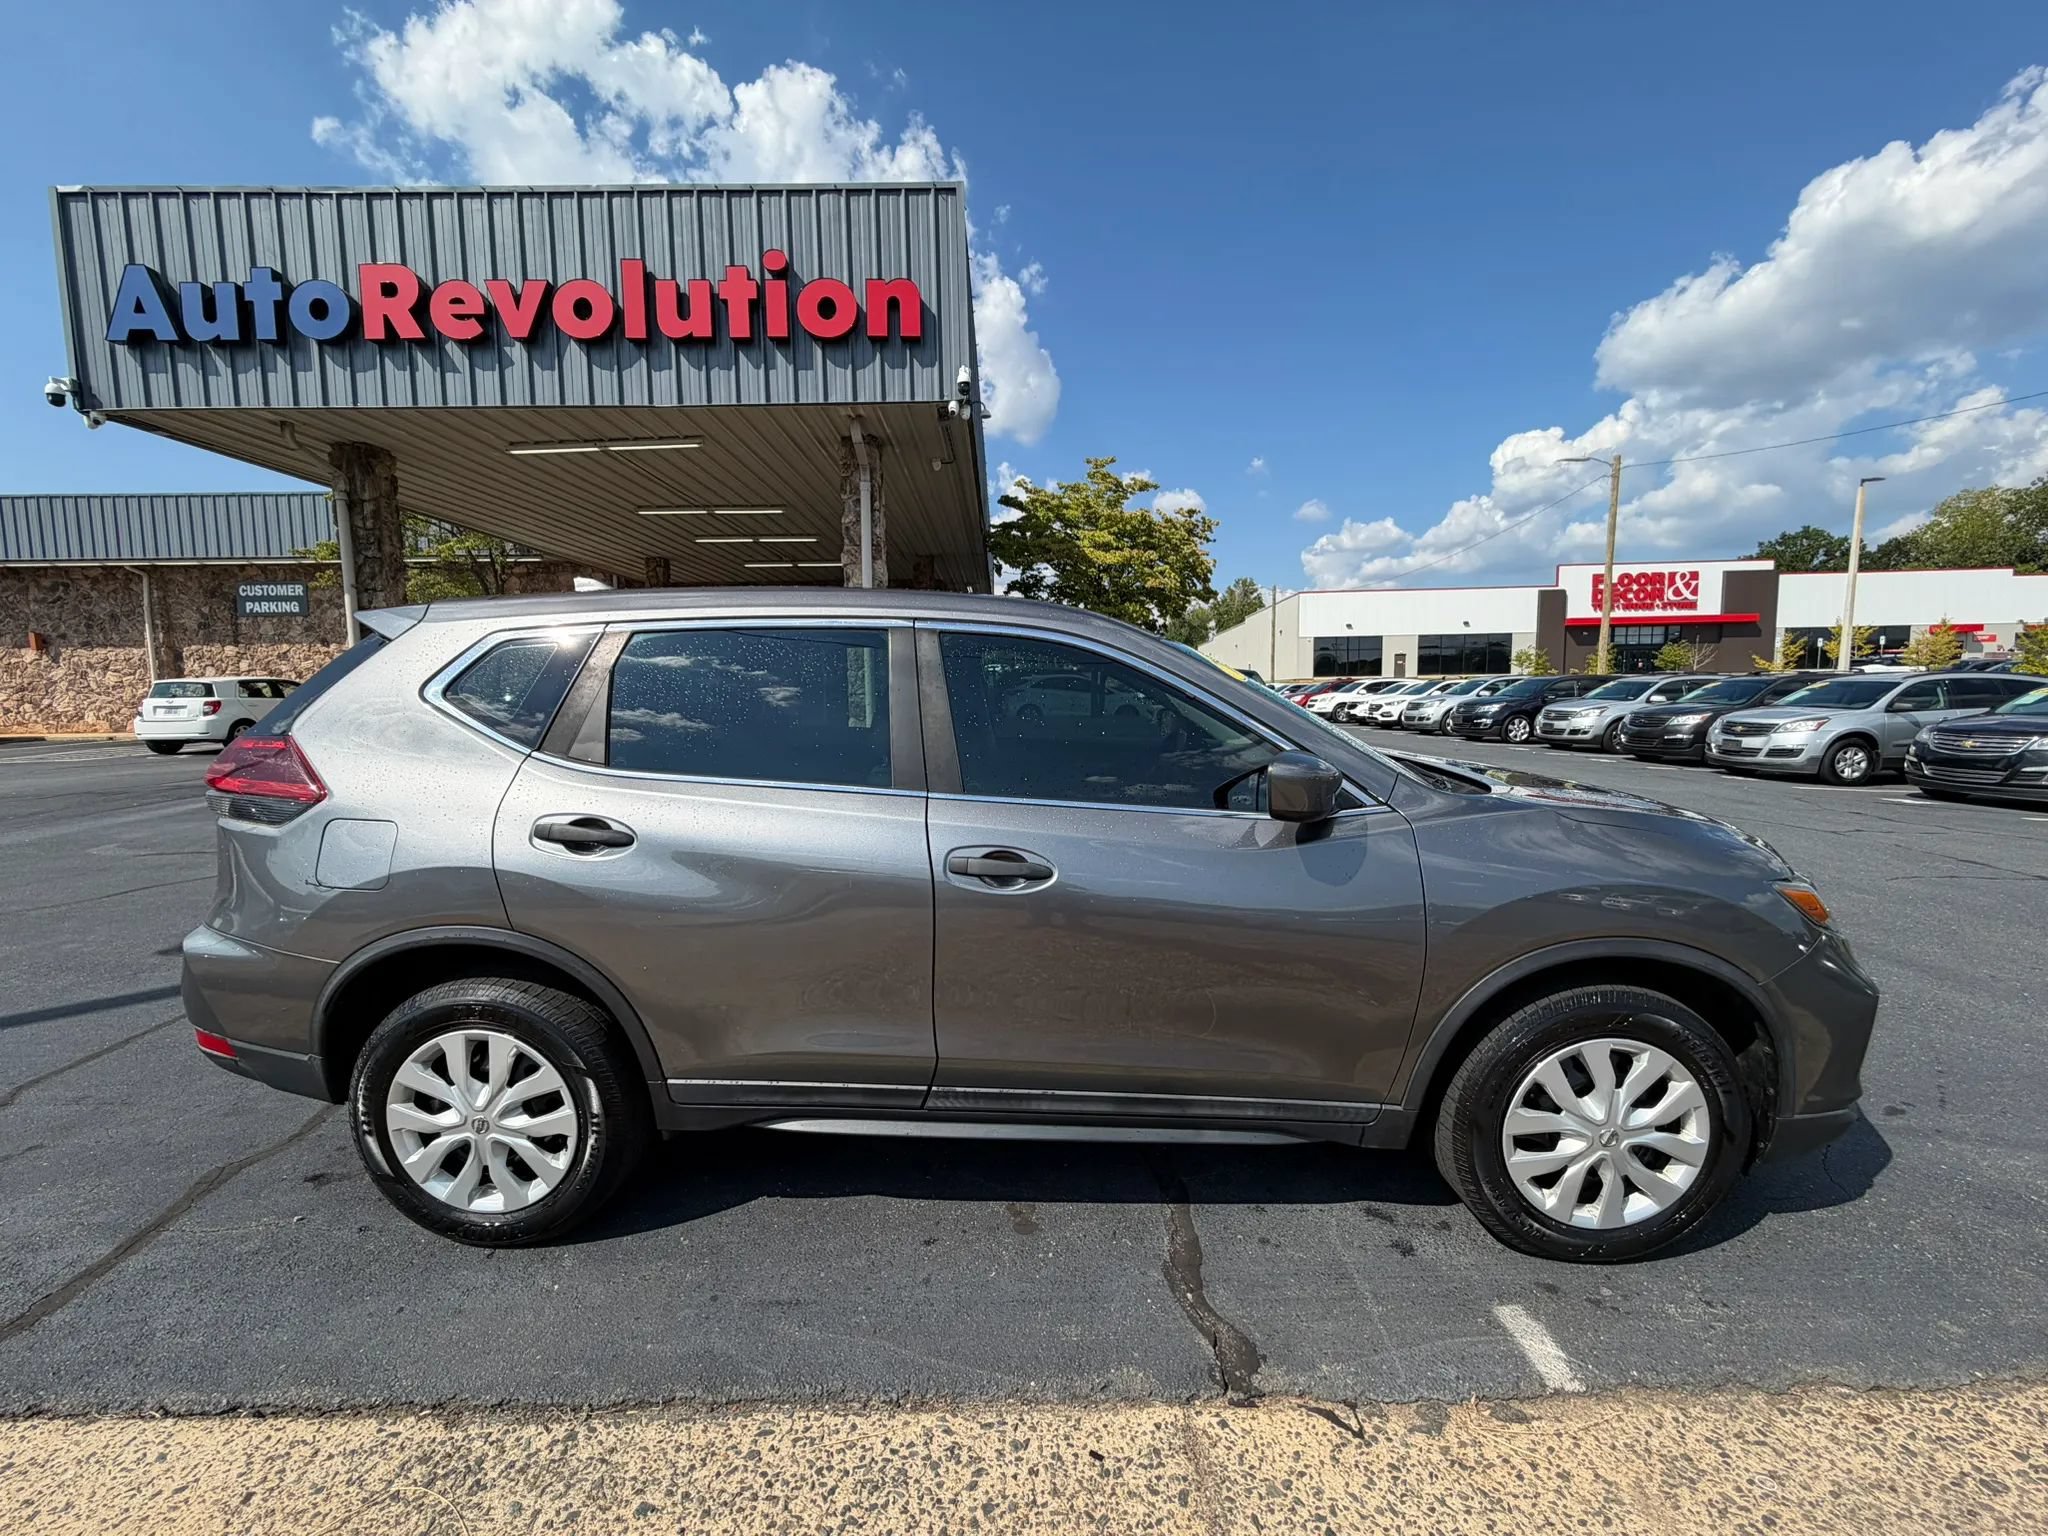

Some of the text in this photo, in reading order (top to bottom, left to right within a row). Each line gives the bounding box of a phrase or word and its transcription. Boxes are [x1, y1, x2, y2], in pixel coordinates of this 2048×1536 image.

[106, 248, 923, 344] AutoRevolution
[239, 584, 304, 597] CUSTOMER
[245, 601, 300, 613] PARKING
